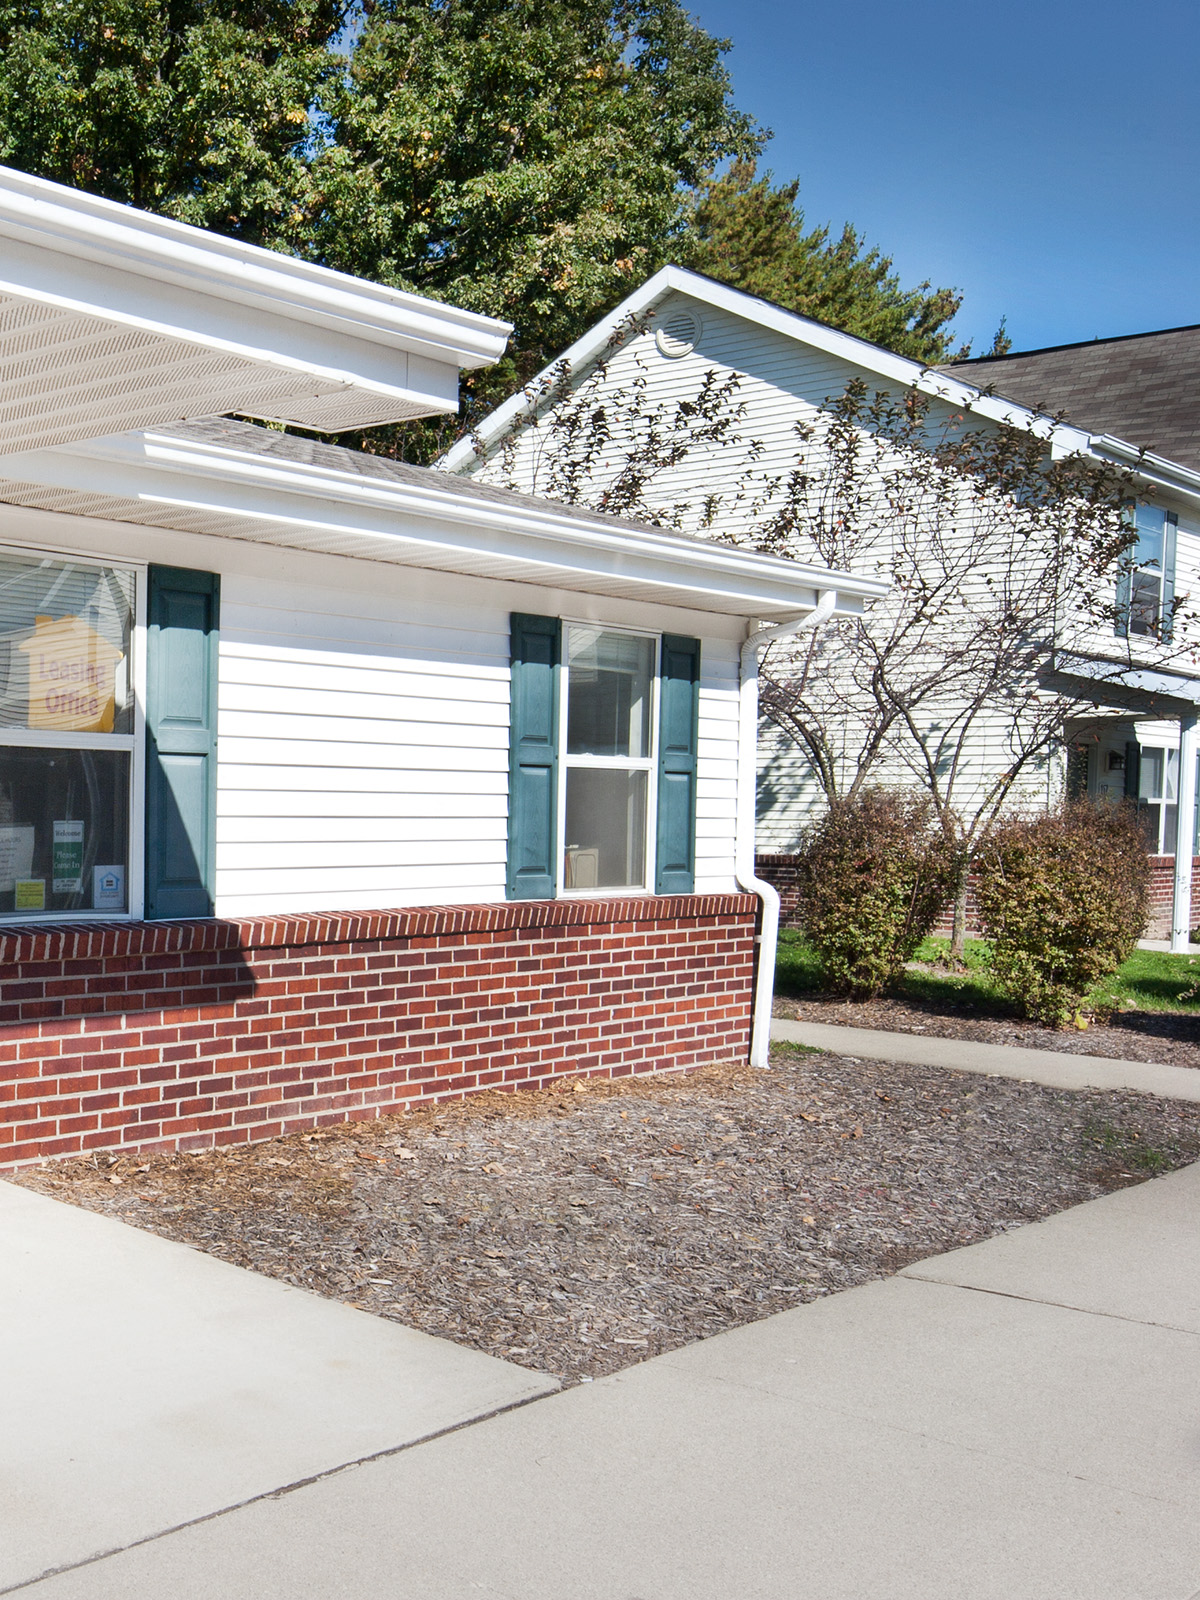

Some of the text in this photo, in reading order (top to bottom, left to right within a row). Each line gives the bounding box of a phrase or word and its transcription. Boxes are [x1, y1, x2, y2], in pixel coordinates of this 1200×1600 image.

[39, 653, 105, 690] Leasing
[46, 687, 99, 716] Office
[55, 829, 81, 837] Welcome
[56, 850, 77, 859] Please
